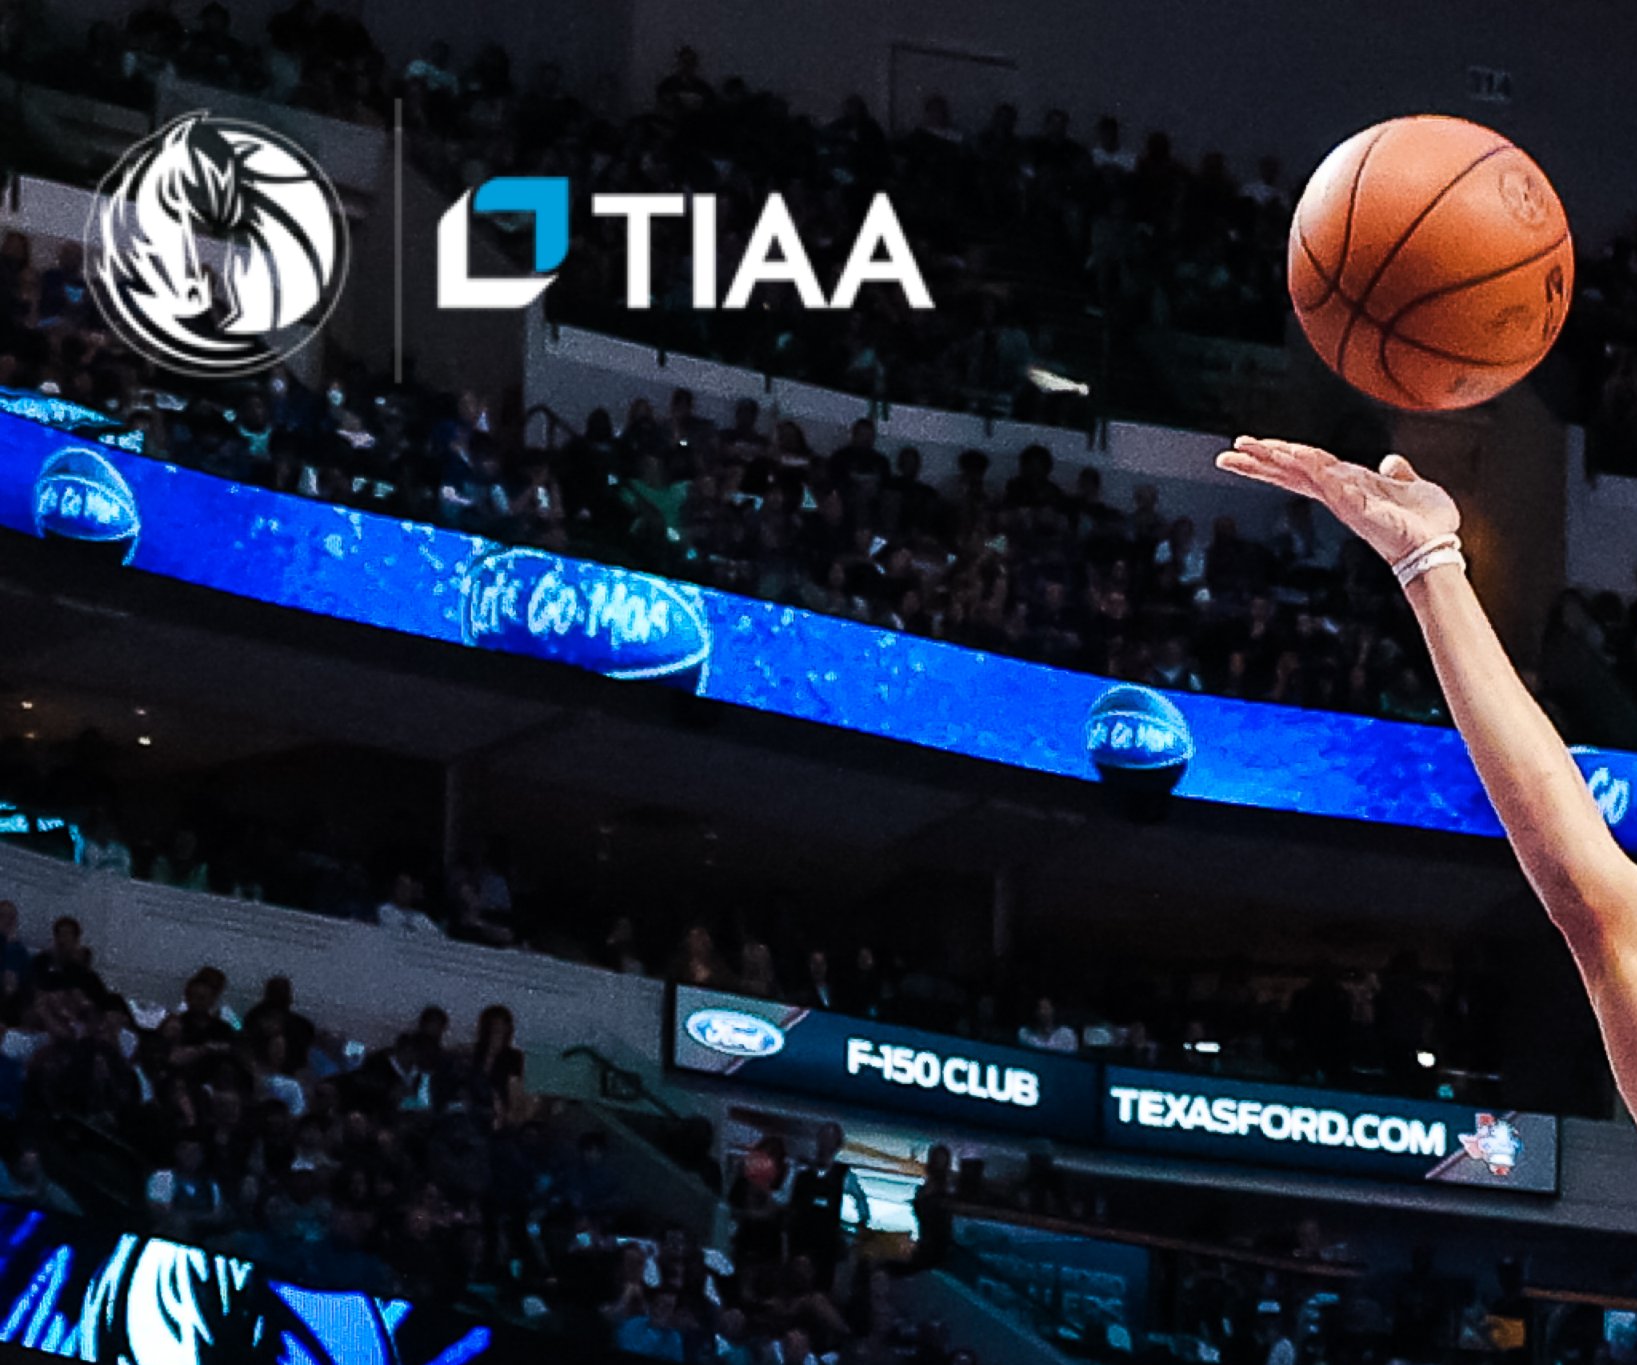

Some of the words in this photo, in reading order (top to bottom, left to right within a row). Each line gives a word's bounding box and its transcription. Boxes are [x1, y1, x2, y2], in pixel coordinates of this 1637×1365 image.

[846, 1037, 941, 1088] F-150
[942, 1060, 1040, 1107] CLUB
[1110, 1085, 1447, 1157] TEXASFORD.COM
